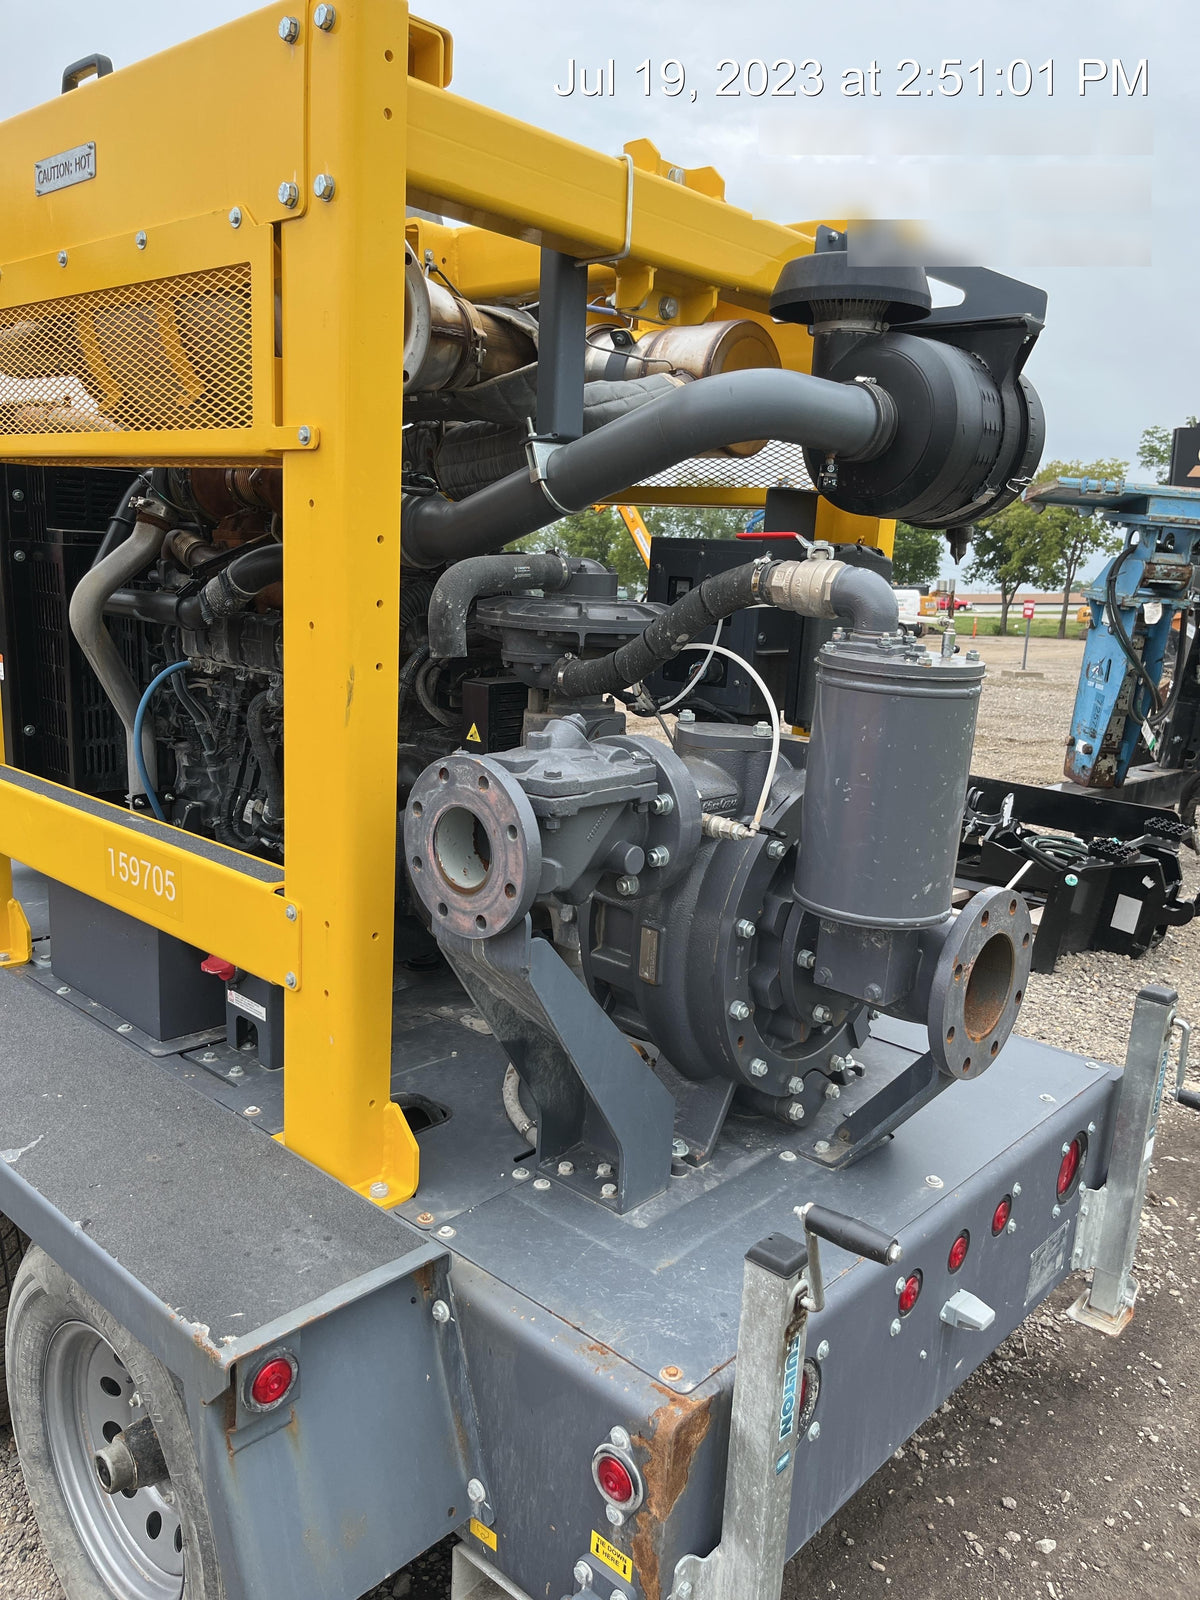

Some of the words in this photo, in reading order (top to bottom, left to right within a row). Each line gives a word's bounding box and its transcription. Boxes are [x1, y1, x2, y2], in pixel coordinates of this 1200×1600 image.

[37, 160, 73, 185] CAUTION:
[75, 152, 92, 173] HOT
[107, 847, 176, 901] 159705
[779, 1334, 800, 1441] FULTON
[596, 1537, 607, 1549] TIE
[607, 1545, 627, 1564] DOWN
[602, 1550, 620, 1567] HERE
